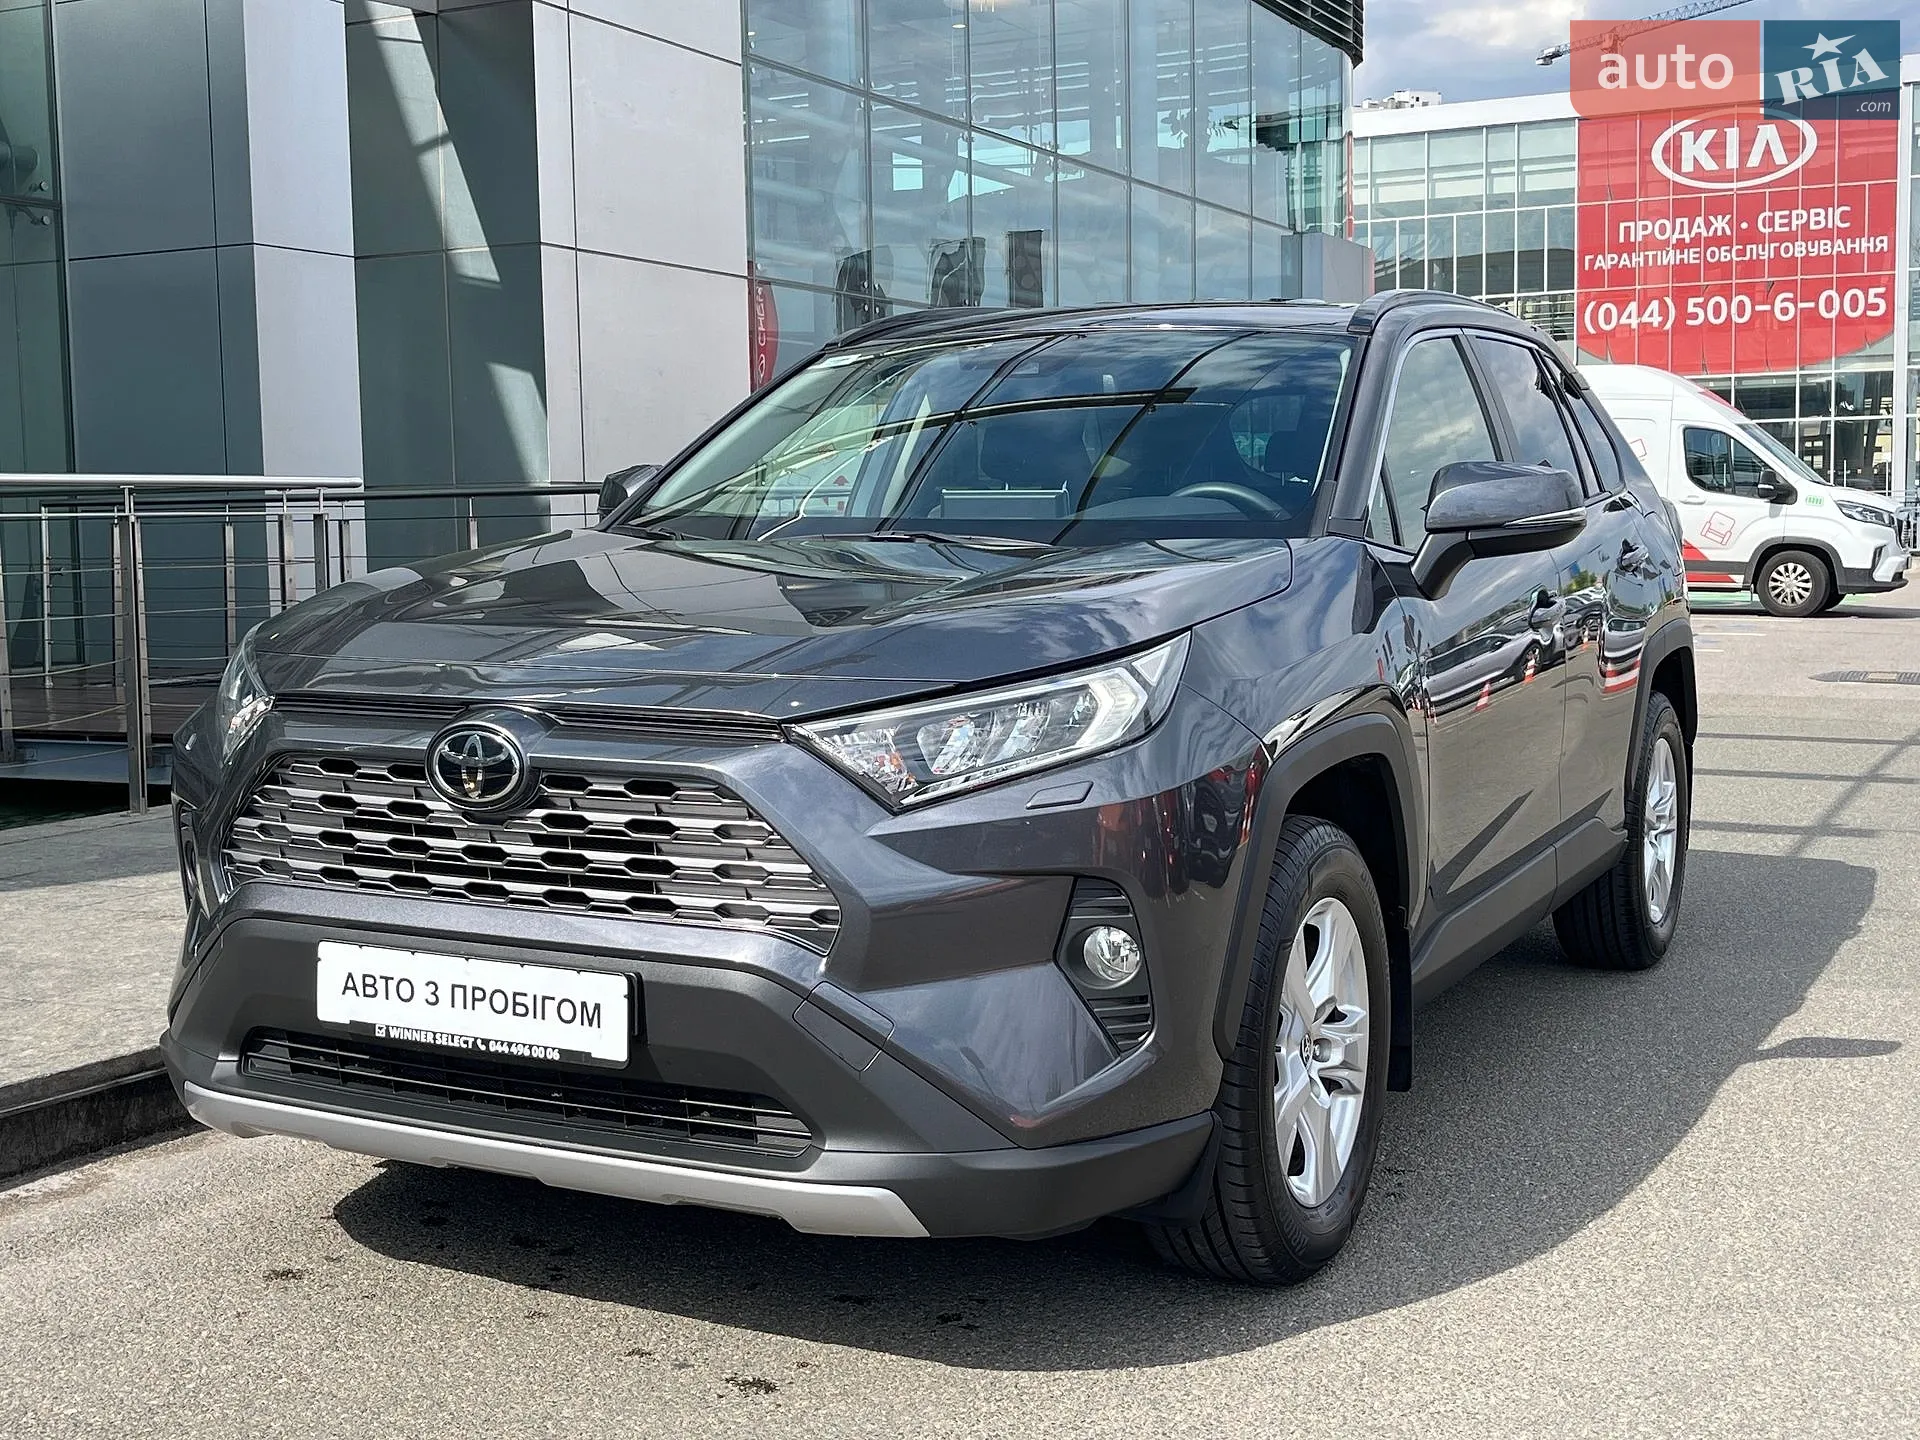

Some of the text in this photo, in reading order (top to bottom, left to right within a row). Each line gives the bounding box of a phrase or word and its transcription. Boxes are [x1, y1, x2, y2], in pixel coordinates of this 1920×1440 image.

[1680, 123, 1790, 173] KIA
[1618, 206, 1851, 244] ПРОДАЖ СЕРВІС
[1584, 235, 1889, 271] ГАРАНТІЙНЕ ОБСЛУГОВУВАННЯ
[1583, 287, 1887, 334] (044) 500-6-005
[341, 972, 415, 1003] АВТО
[451, 983, 601, 1029] ПРОБІГОМ
[388, 1026, 560, 1061] WINNER SELECT 044 496 00 06
